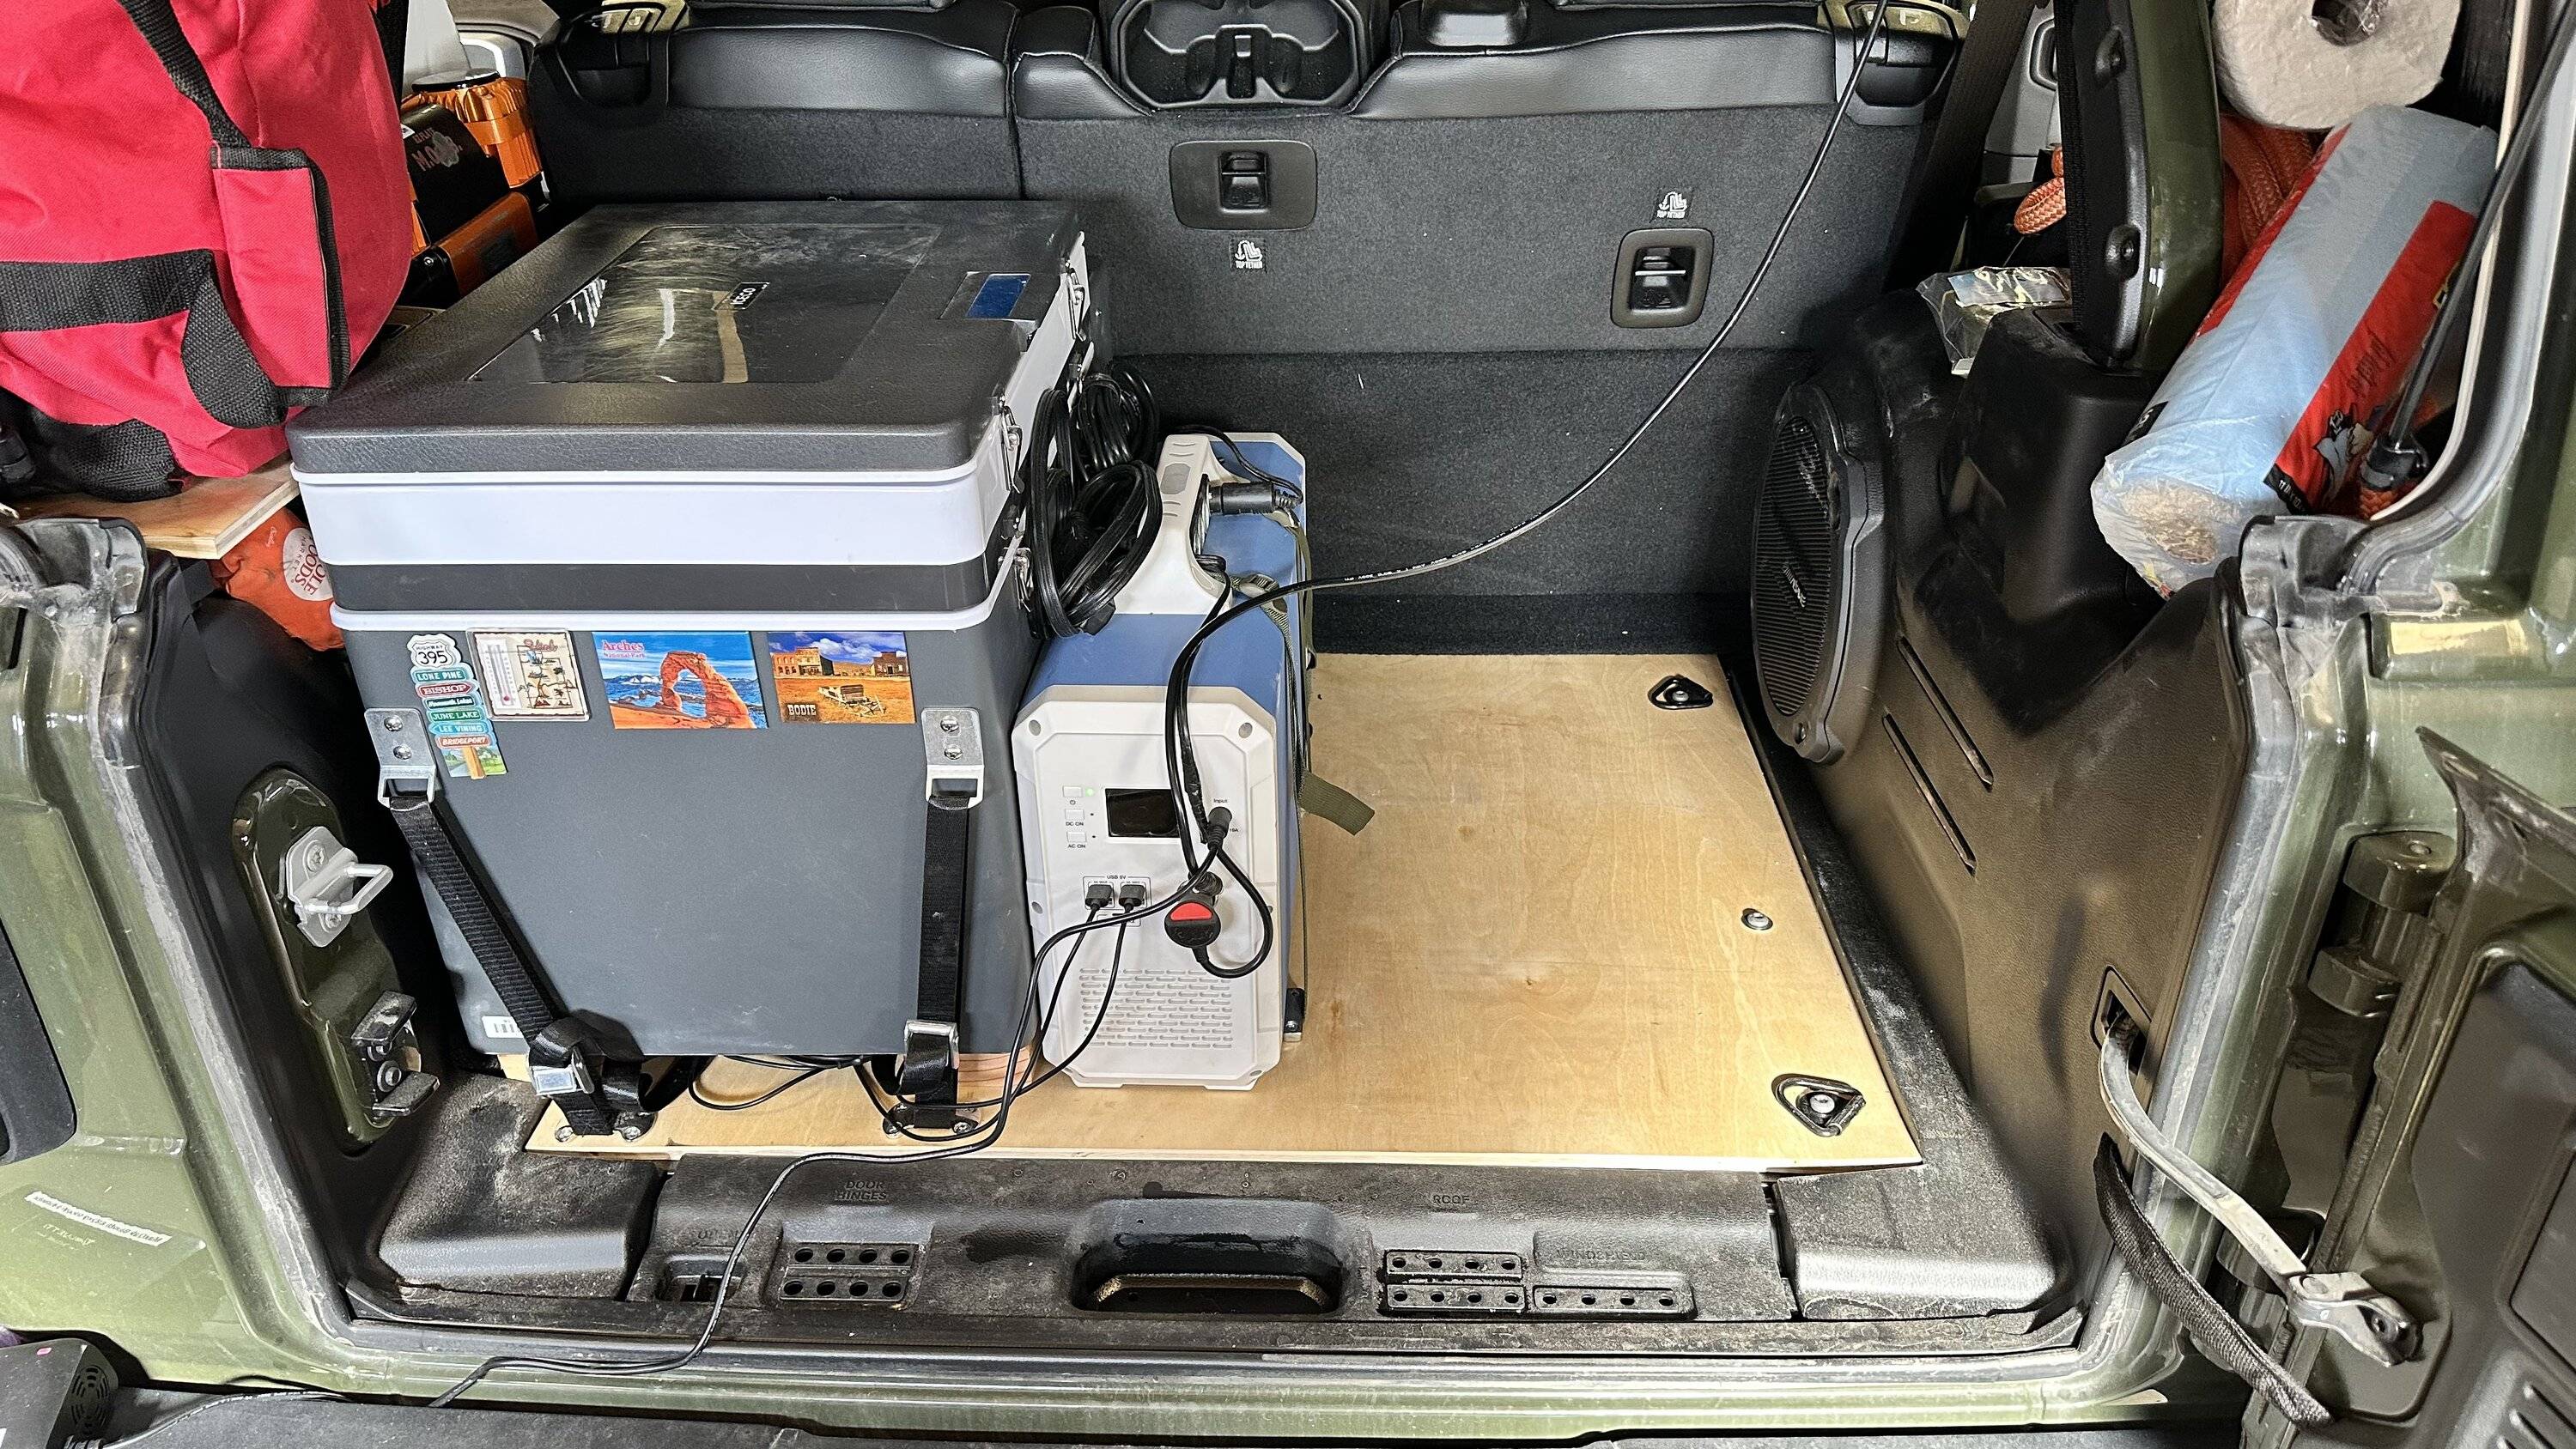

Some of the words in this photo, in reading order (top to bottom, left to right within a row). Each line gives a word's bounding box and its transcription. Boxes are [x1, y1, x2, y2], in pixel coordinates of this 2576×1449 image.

[1656, 209, 1668, 219] TOP
[1235, 260, 1246, 269] TOP
[730, 288, 756, 305] ICECO
[295, 544, 319, 586] OODS
[303, 564, 326, 595] OLE
[601, 640, 644, 651] Arches
[418, 650, 448, 665] 395
[416, 672, 440, 681] LONE
[441, 671, 464, 680] PINE
[422, 685, 466, 695] BISHOP
[787, 704, 817, 716] BODIE
[433, 712, 455, 721] JUNE
[442, 737, 486, 745] BRIDGEPORT
[845, 1180, 885, 1190] DOOR
[834, 1189, 888, 1201] HINGES
[1433, 1194, 1470, 1204] ROOF
